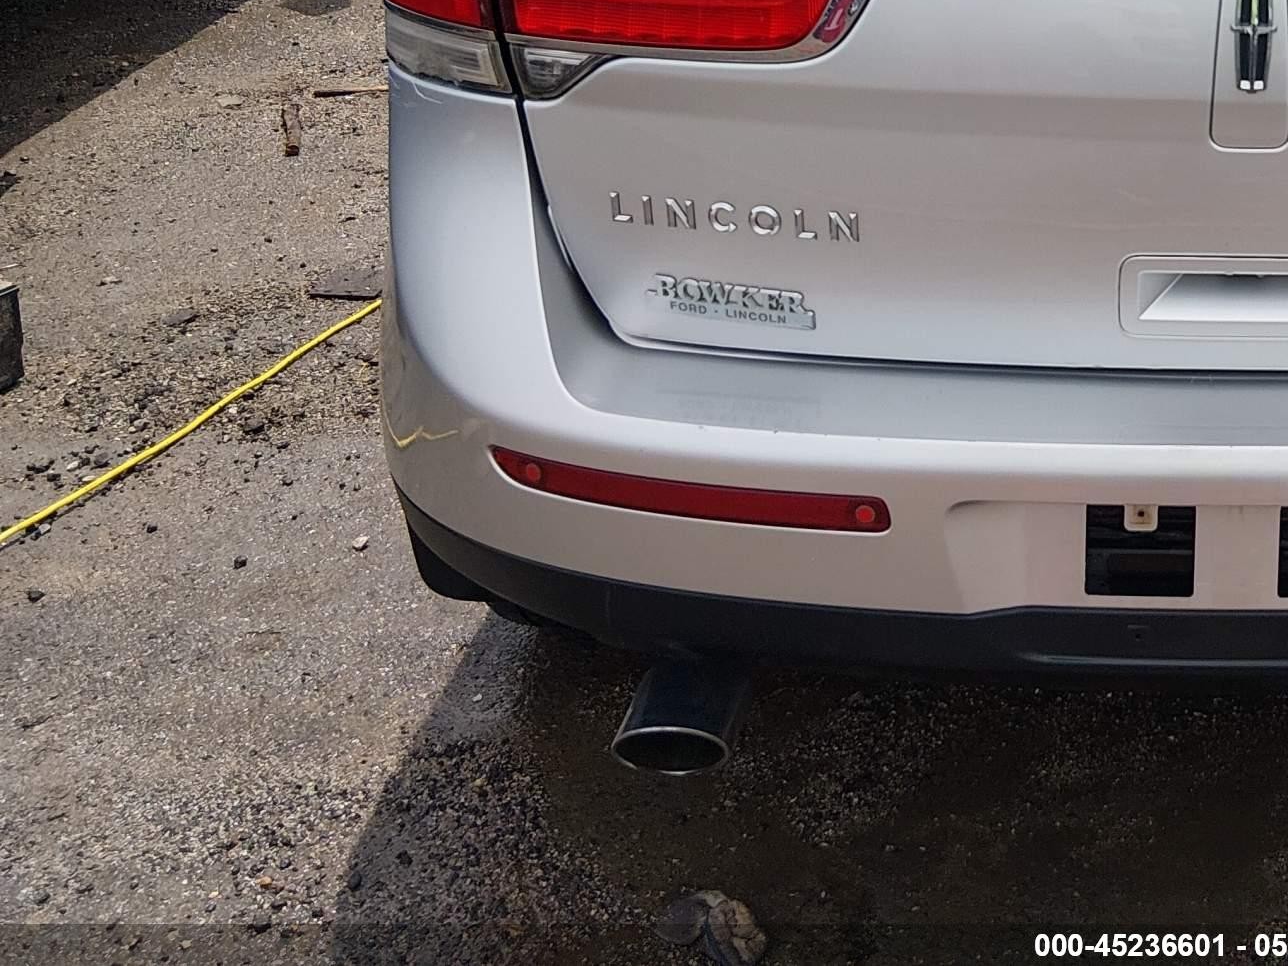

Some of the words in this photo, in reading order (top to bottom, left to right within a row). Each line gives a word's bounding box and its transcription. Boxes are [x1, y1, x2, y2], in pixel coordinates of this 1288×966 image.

[608, 191, 860, 243] LINCOLN
[652, 272, 808, 315] BOWKER
[669, 301, 708, 316] FORD
[724, 308, 788, 325] LINCOLN
